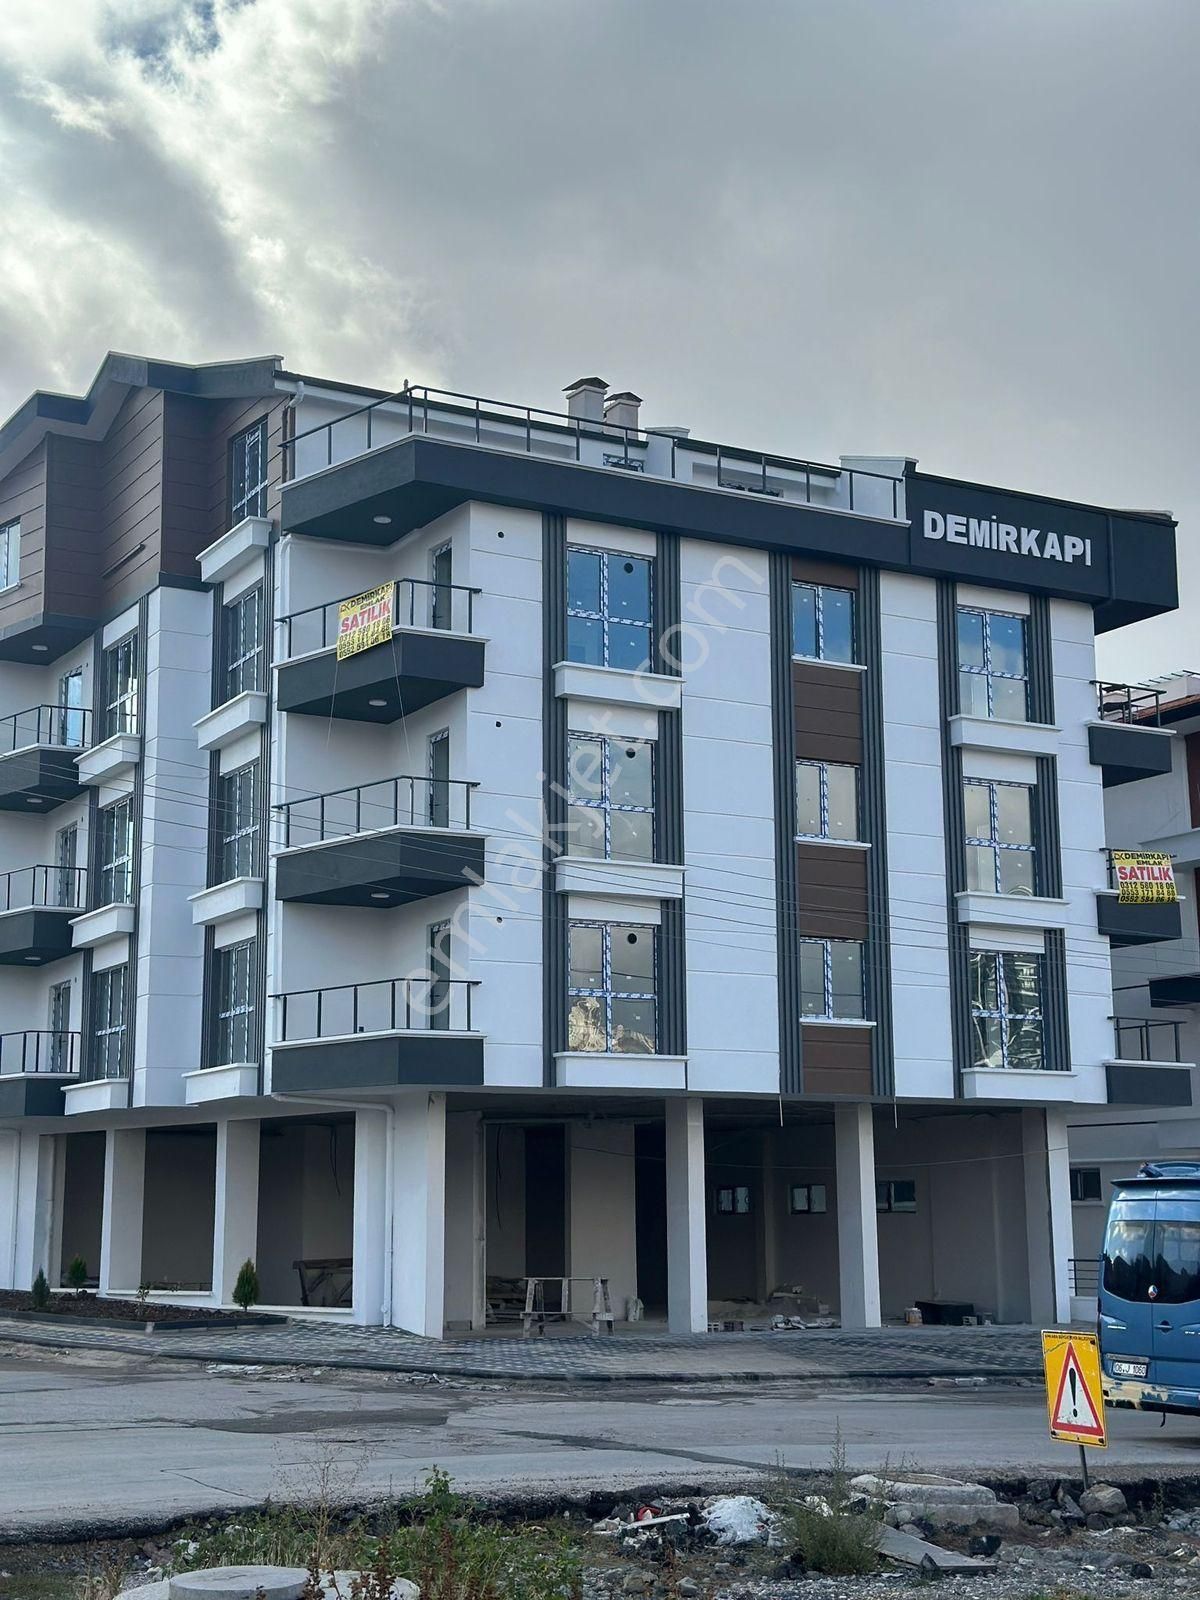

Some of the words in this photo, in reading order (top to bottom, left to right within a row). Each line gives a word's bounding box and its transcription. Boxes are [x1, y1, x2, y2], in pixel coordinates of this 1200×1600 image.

[341, 599, 391, 634] SATILIK
[1117, 866, 1173, 881] SATILIK
[1120, 881, 1138, 889] 0312
